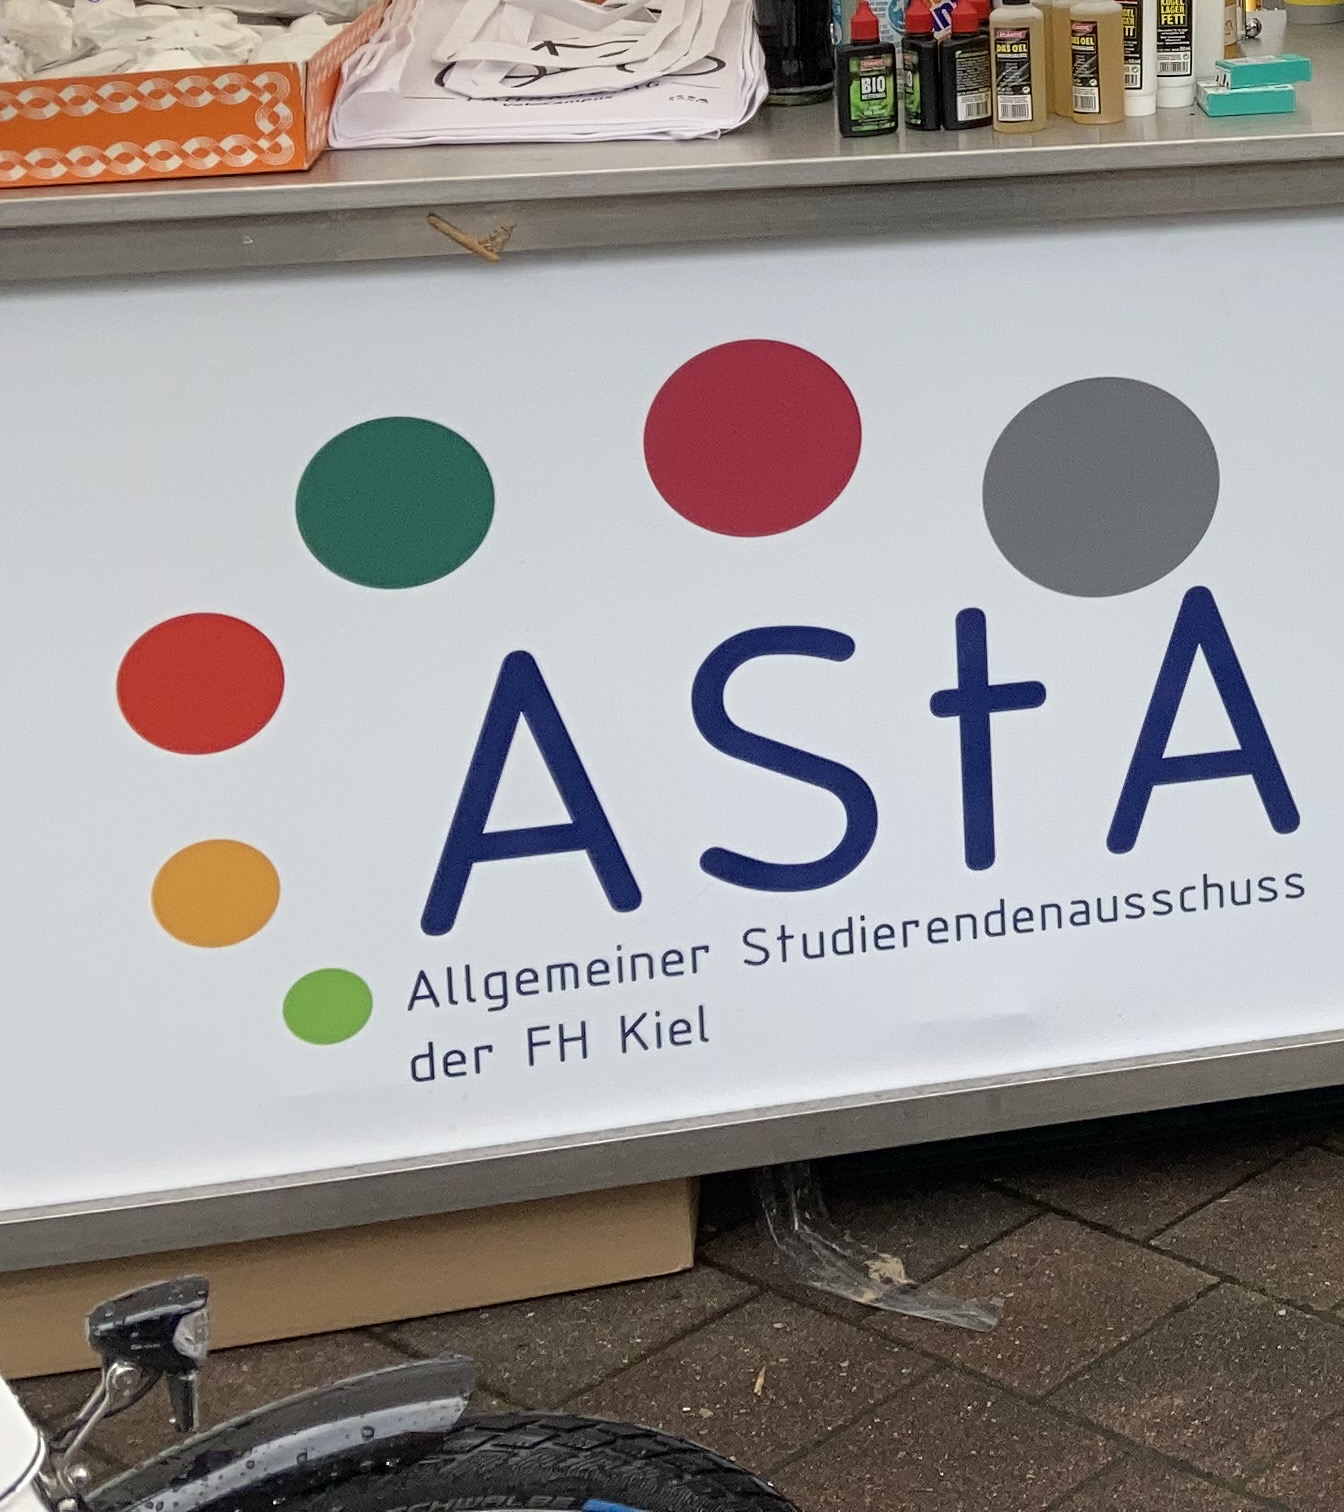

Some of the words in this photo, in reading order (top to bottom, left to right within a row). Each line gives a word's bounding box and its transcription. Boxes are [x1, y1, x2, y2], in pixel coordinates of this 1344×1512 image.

[1160, 5, 1185, 14] LAGER
[1161, 13, 1186, 25] FETT
[860, 75, 886, 94] BIO
[421, 585, 1301, 936] AStA
[407, 944, 710, 1012] Allgemeiner
[742, 872, 1306, 966] Studierendenausschuss
[410, 1041, 493, 1083] der
[527, 1020, 588, 1067] FH
[620, 1004, 710, 1054] Kiel
